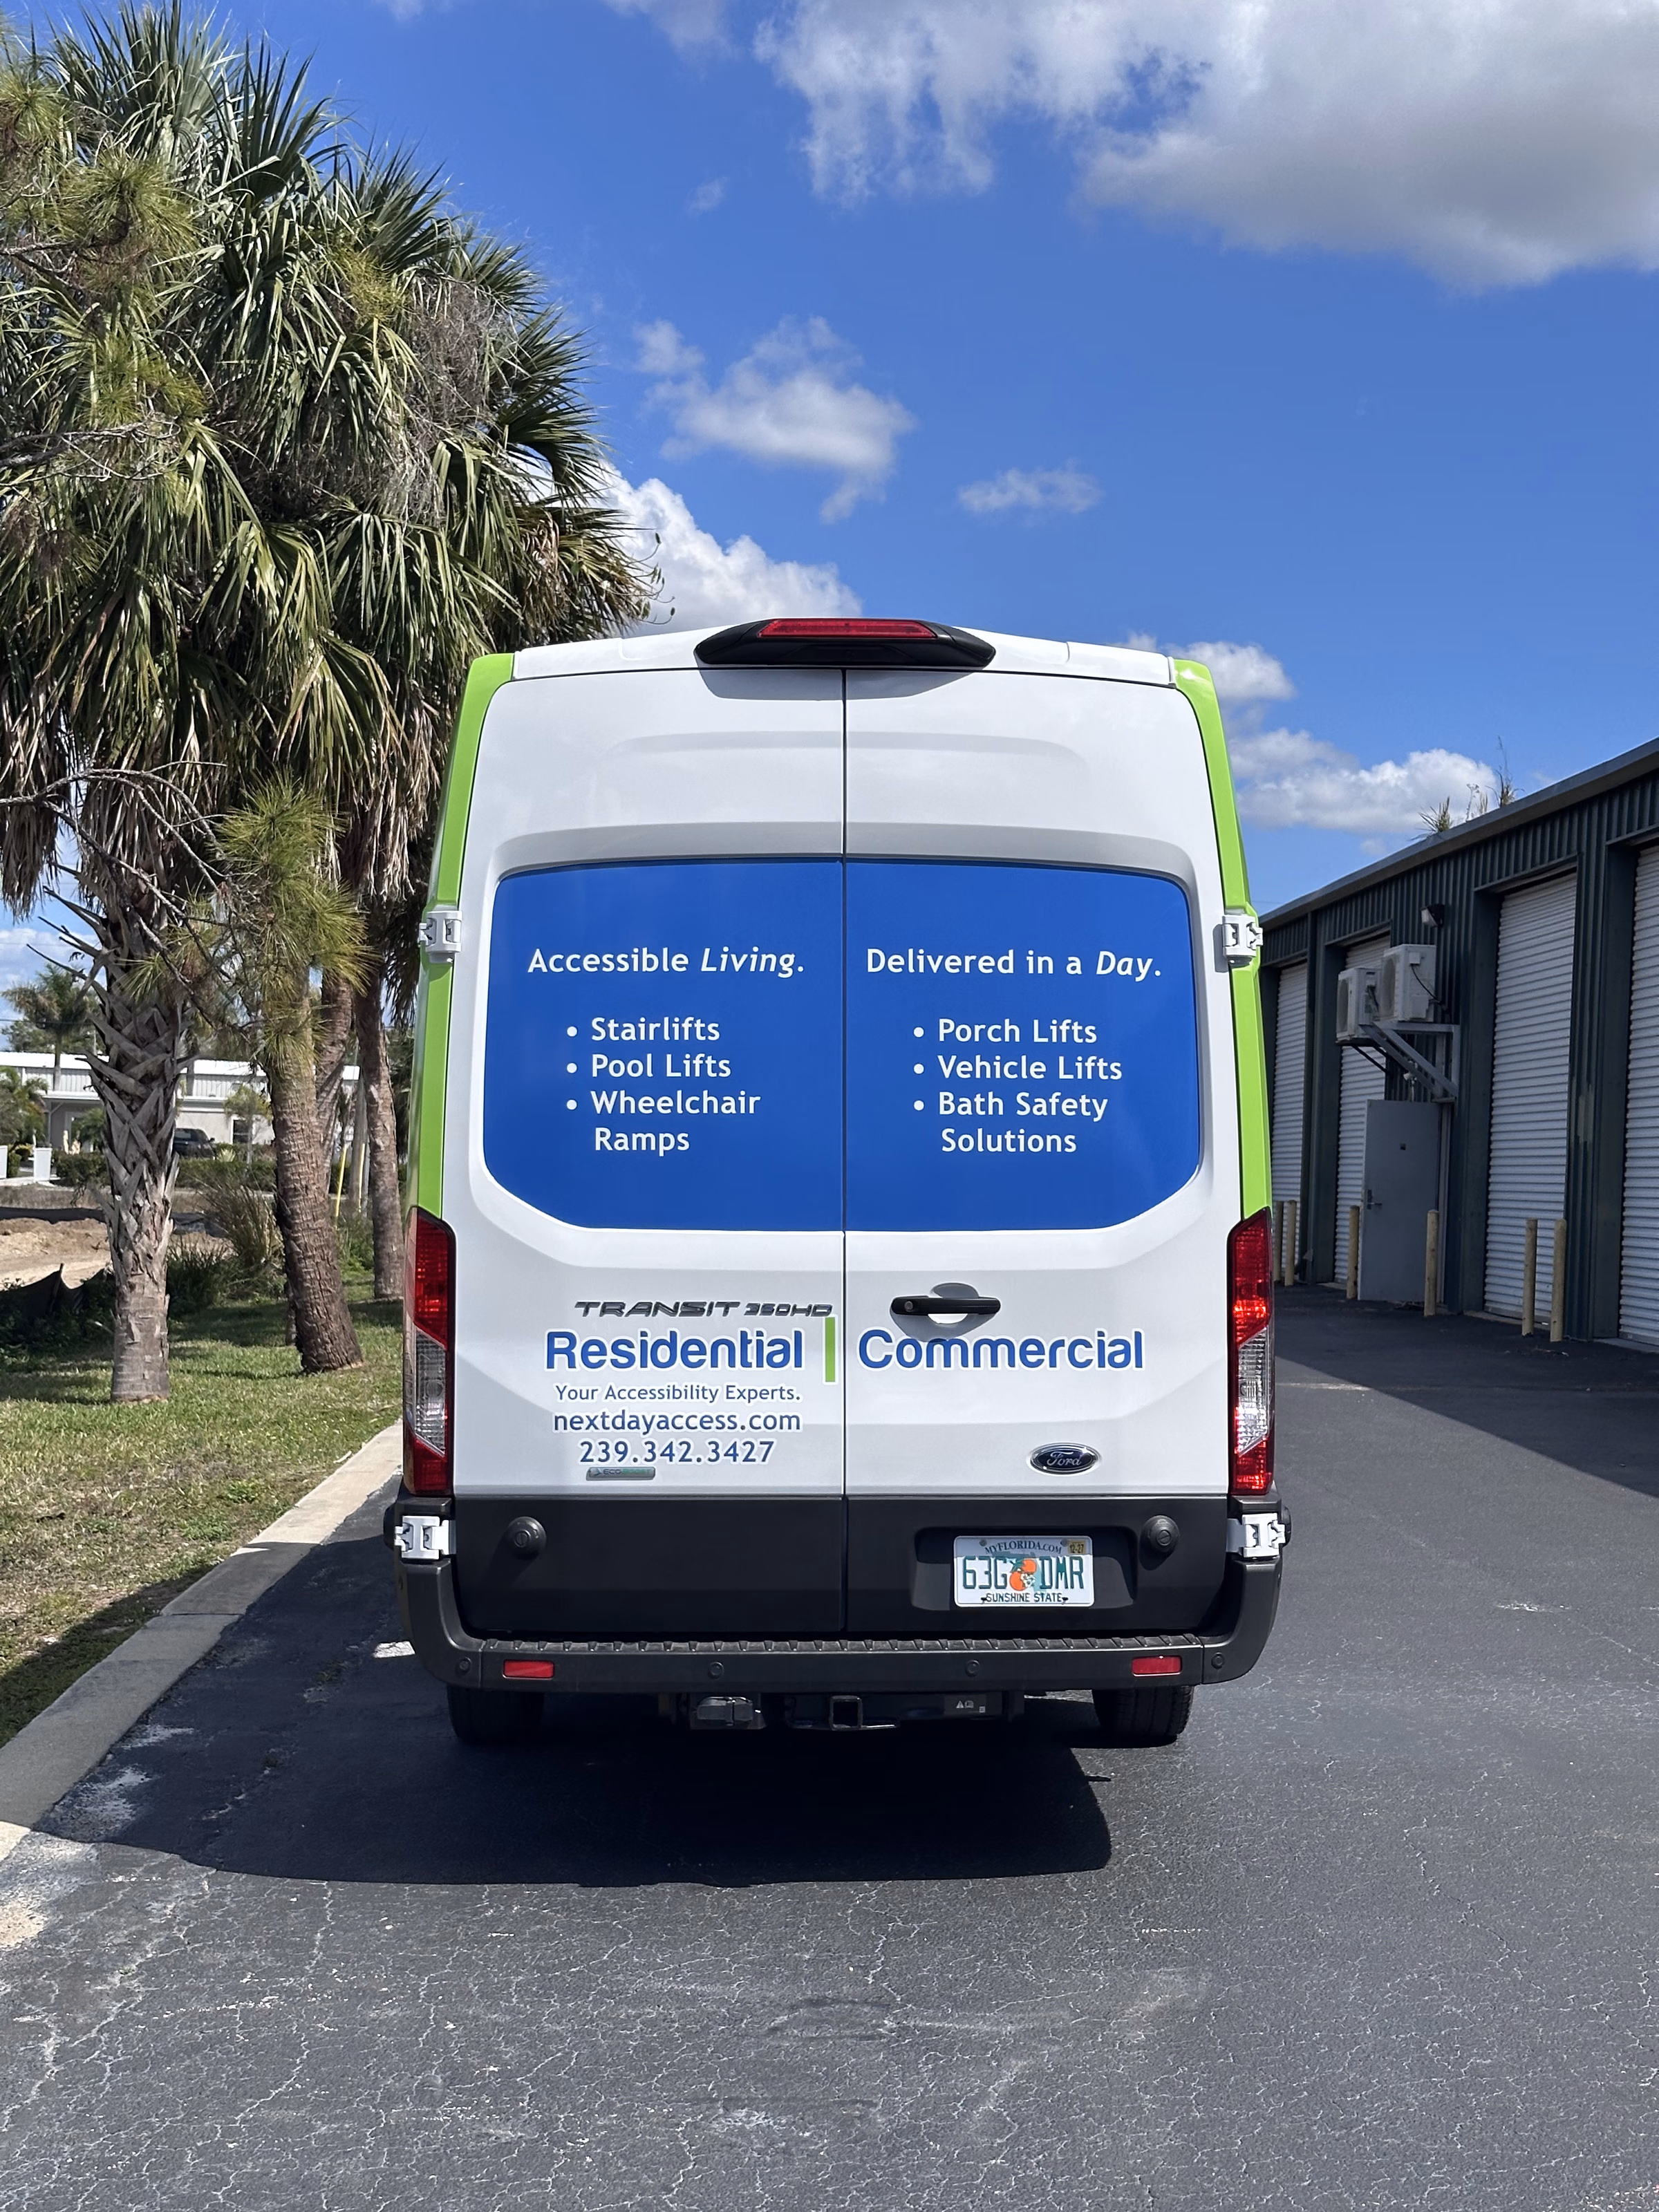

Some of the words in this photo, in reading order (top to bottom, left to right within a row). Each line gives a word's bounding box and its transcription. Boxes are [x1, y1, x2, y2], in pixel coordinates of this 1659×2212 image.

[528, 948, 689, 973] Accessible
[701, 947, 805, 978] Living.
[868, 948, 1014, 974] Delivered
[1027, 950, 1053, 974] in
[1066, 956, 1082, 975] a
[1096, 951, 1161, 982] Day.
[592, 1017, 720, 1041] Stairlifts
[939, 1018, 1020, 1042] Porch
[1033, 1019, 1097, 1043] Lifts
[592, 1053, 653, 1078] Pool
[666, 1053, 731, 1078] Lifts
[937, 1055, 1047, 1079] Vehicle
[1058, 1056, 1122, 1080] Lifts
[590, 1089, 761, 1114] Wheelchair
[939, 1091, 1004, 1116] Bath
[1016, 1092, 1108, 1122] Safety
[595, 1127, 690, 1157] Ramps
[941, 1128, 1077, 1152] Solutions
[574, 1301, 740, 1318] TRANSIT
[744, 1303, 833, 1317] 350HD
[546, 1331, 803, 1369] Residential
[859, 1329, 1143, 1369] Commercial
[555, 1385, 599, 1400] Your
[605, 1385, 719, 1403] Accessibility
[726, 1385, 800, 1404] Experts.
[554, 1409, 801, 1436] nextdayaccess.com
[580, 1441, 775, 1463] 239.342.3427
[1047, 1451, 1082, 1465] Ford
[984, 1540, 1062, 1555] MYFLORIDA.COM
[963, 1556, 1007, 1589] 63G
[1040, 1556, 1084, 1589] DMR
[986, 1592, 1030, 1603] SUNSHINE
[1033, 1592, 1062, 1603] STATE
